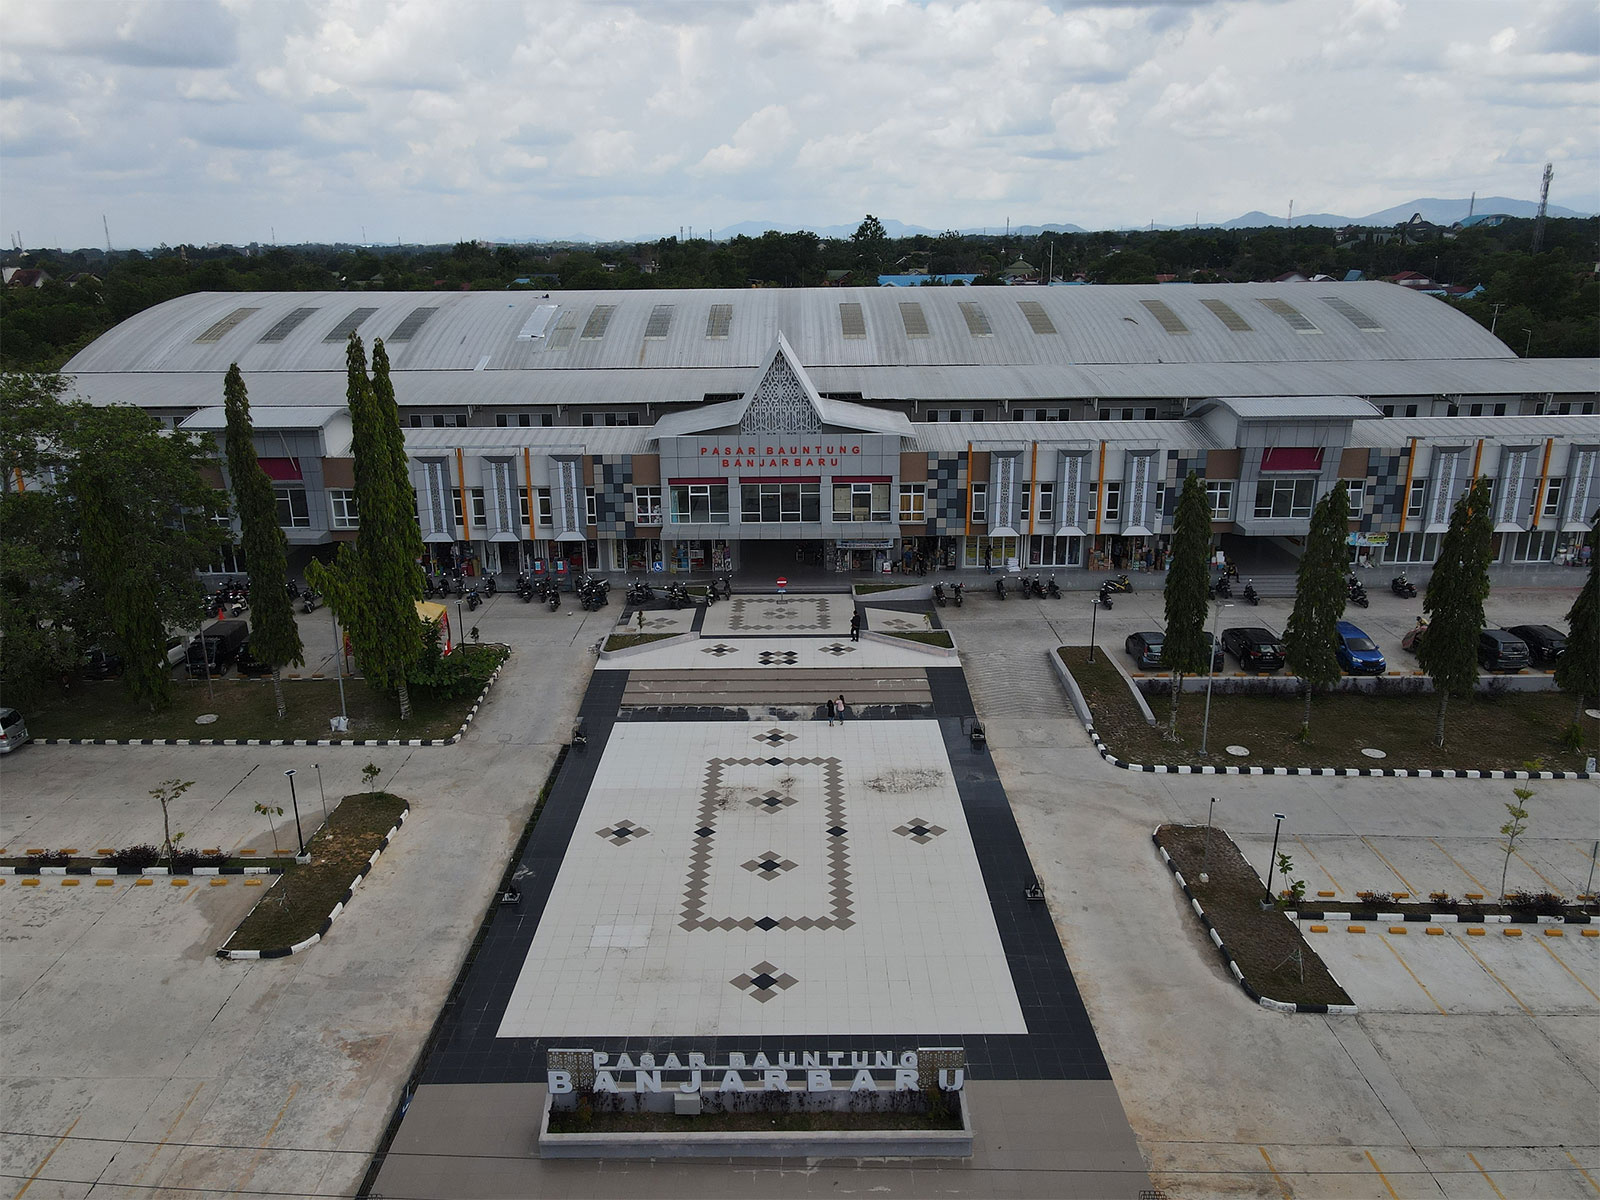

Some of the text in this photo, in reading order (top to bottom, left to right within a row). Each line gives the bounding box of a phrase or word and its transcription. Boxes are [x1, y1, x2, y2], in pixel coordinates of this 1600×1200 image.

[701, 446, 860, 455] PASAR BAUNTUNG
[722, 458, 838, 467] BANJARBARU
[593, 1050, 918, 1068] PASAR BAUNTUNG
[548, 1069, 964, 1093] BANJARBARU
